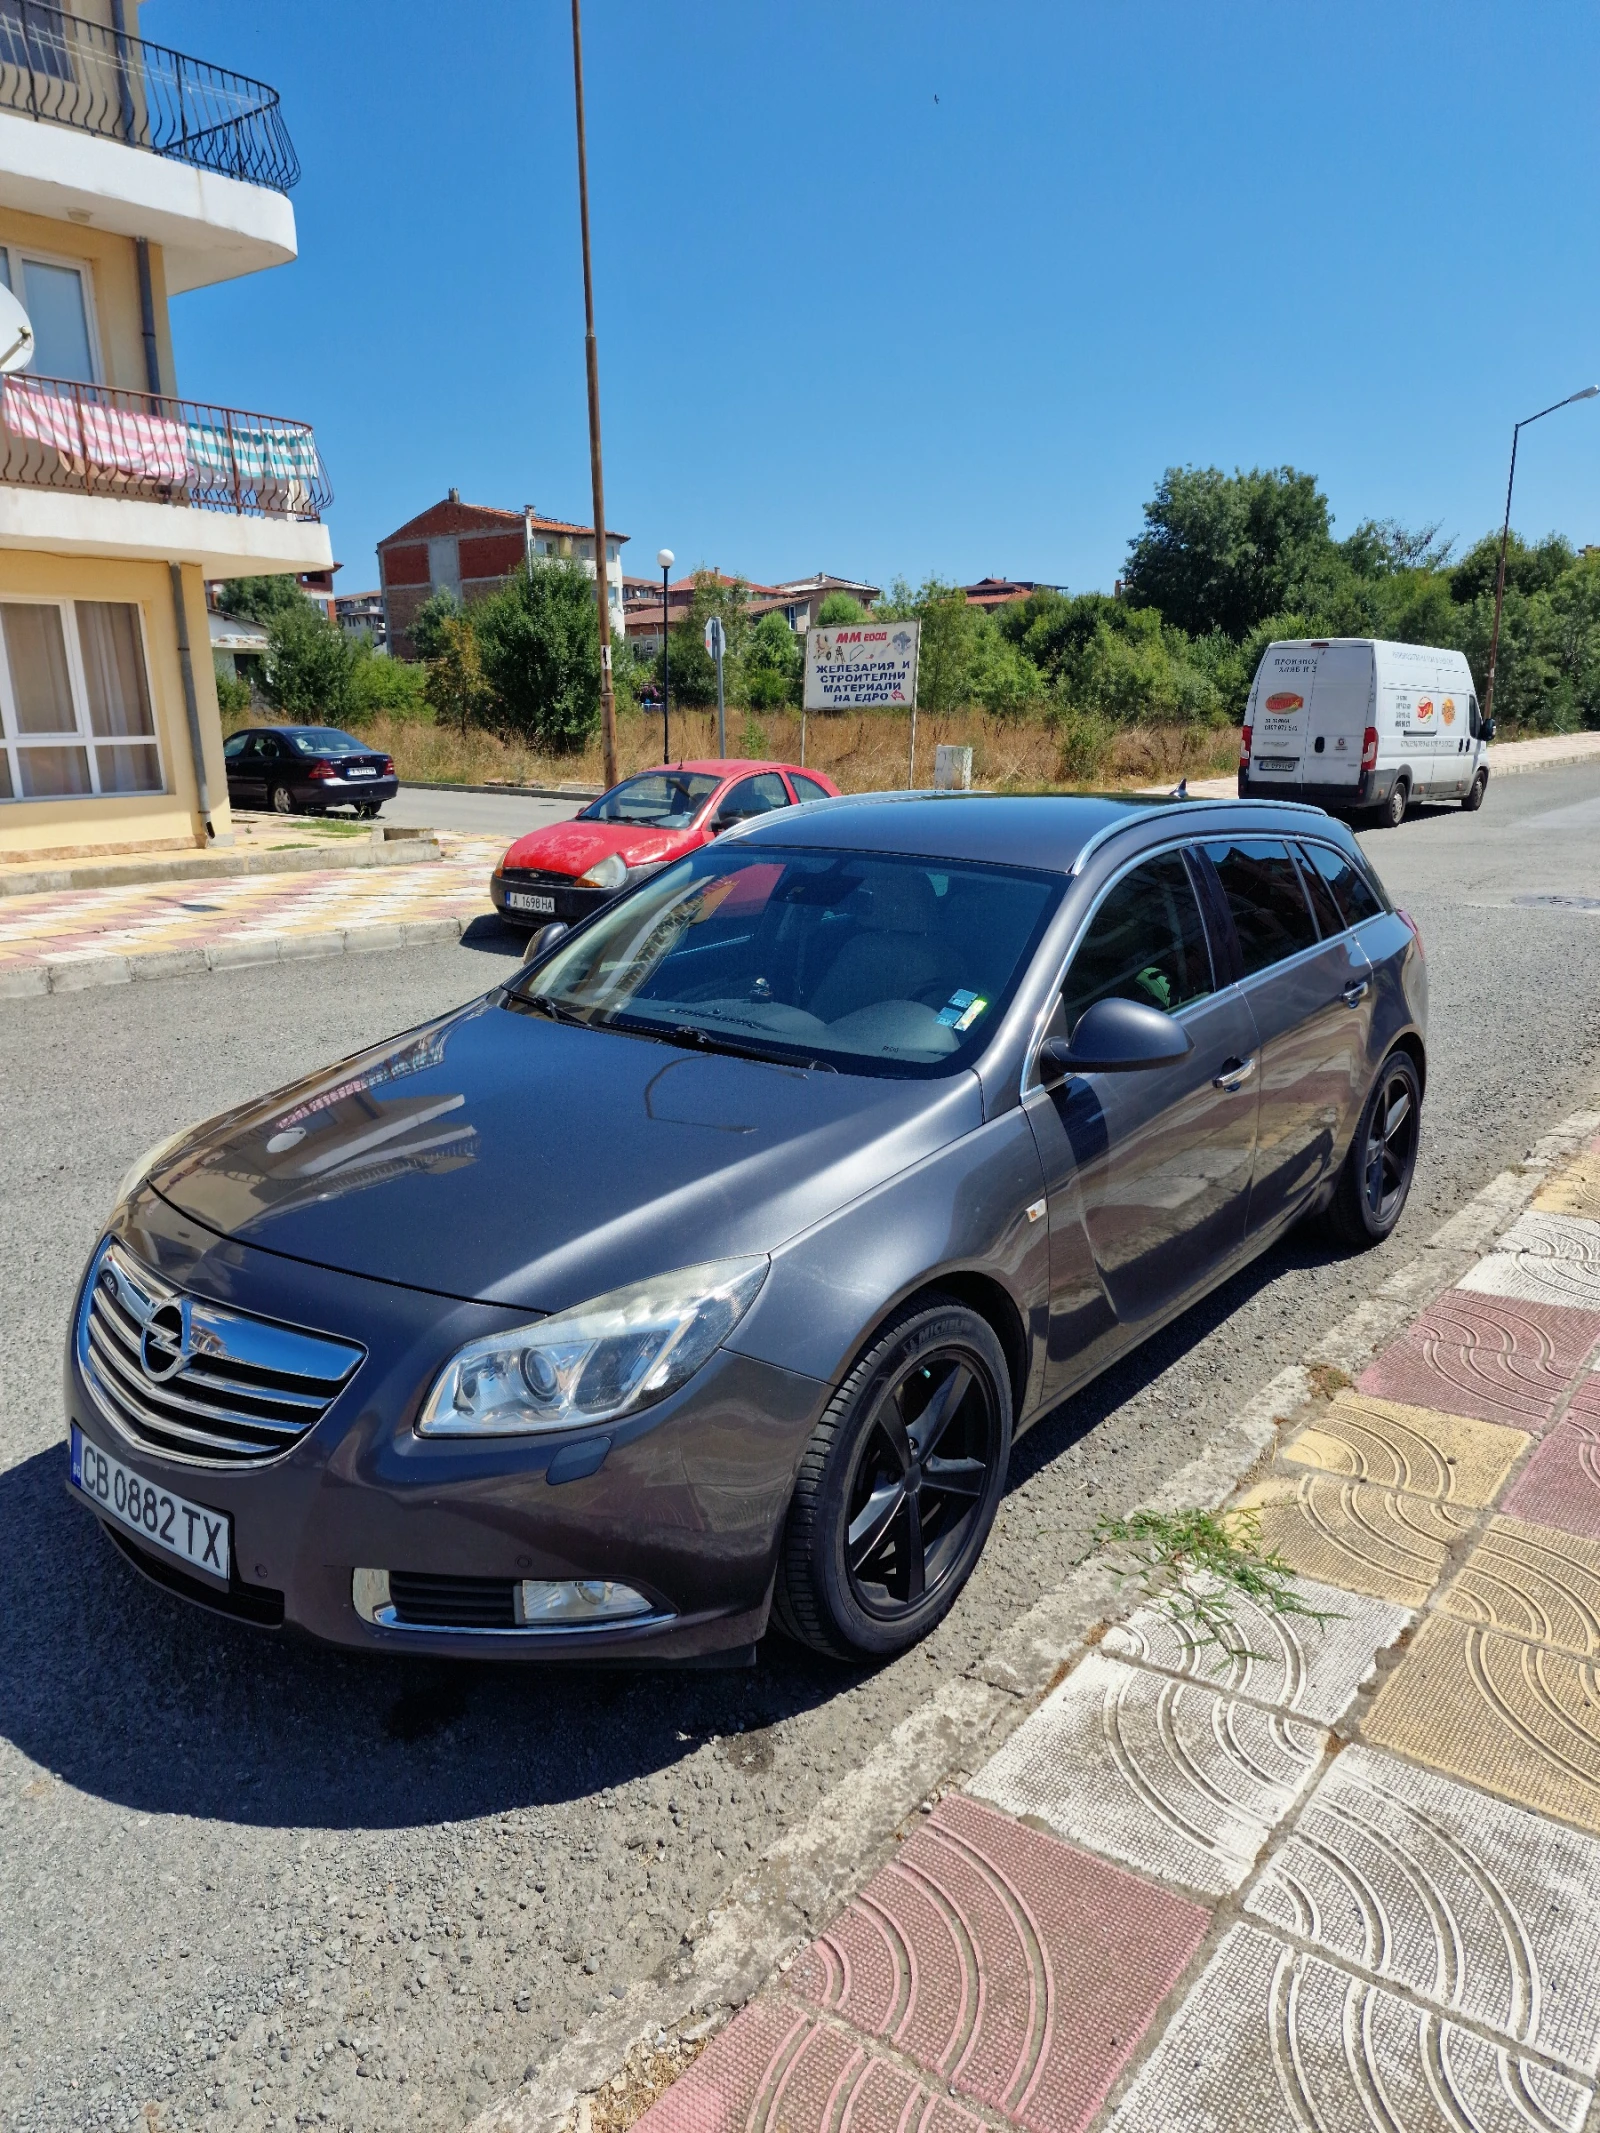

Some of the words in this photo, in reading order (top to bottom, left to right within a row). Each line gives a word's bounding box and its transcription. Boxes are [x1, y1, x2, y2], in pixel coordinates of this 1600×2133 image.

[816, 661, 895, 674] ЖЕЛЕЗАРИЯ
[902, 660, 910, 669] И
[820, 671, 906, 684] СТРОИТЕЛНИ
[824, 682, 902, 693] МАТЕРИАЛИ
[833, 694, 851, 702] НА
[854, 692, 889, 703] ЕДРО
[522, 896, 541, 909] 1698
[541, 897, 553, 911] HA
[918, 1319, 973, 1342] MICHELIN
[72, 1462, 81, 1478] BG
[83, 1445, 109, 1501] CB
[114, 1468, 176, 1546] 0882
[181, 1504, 222, 1570] TX
